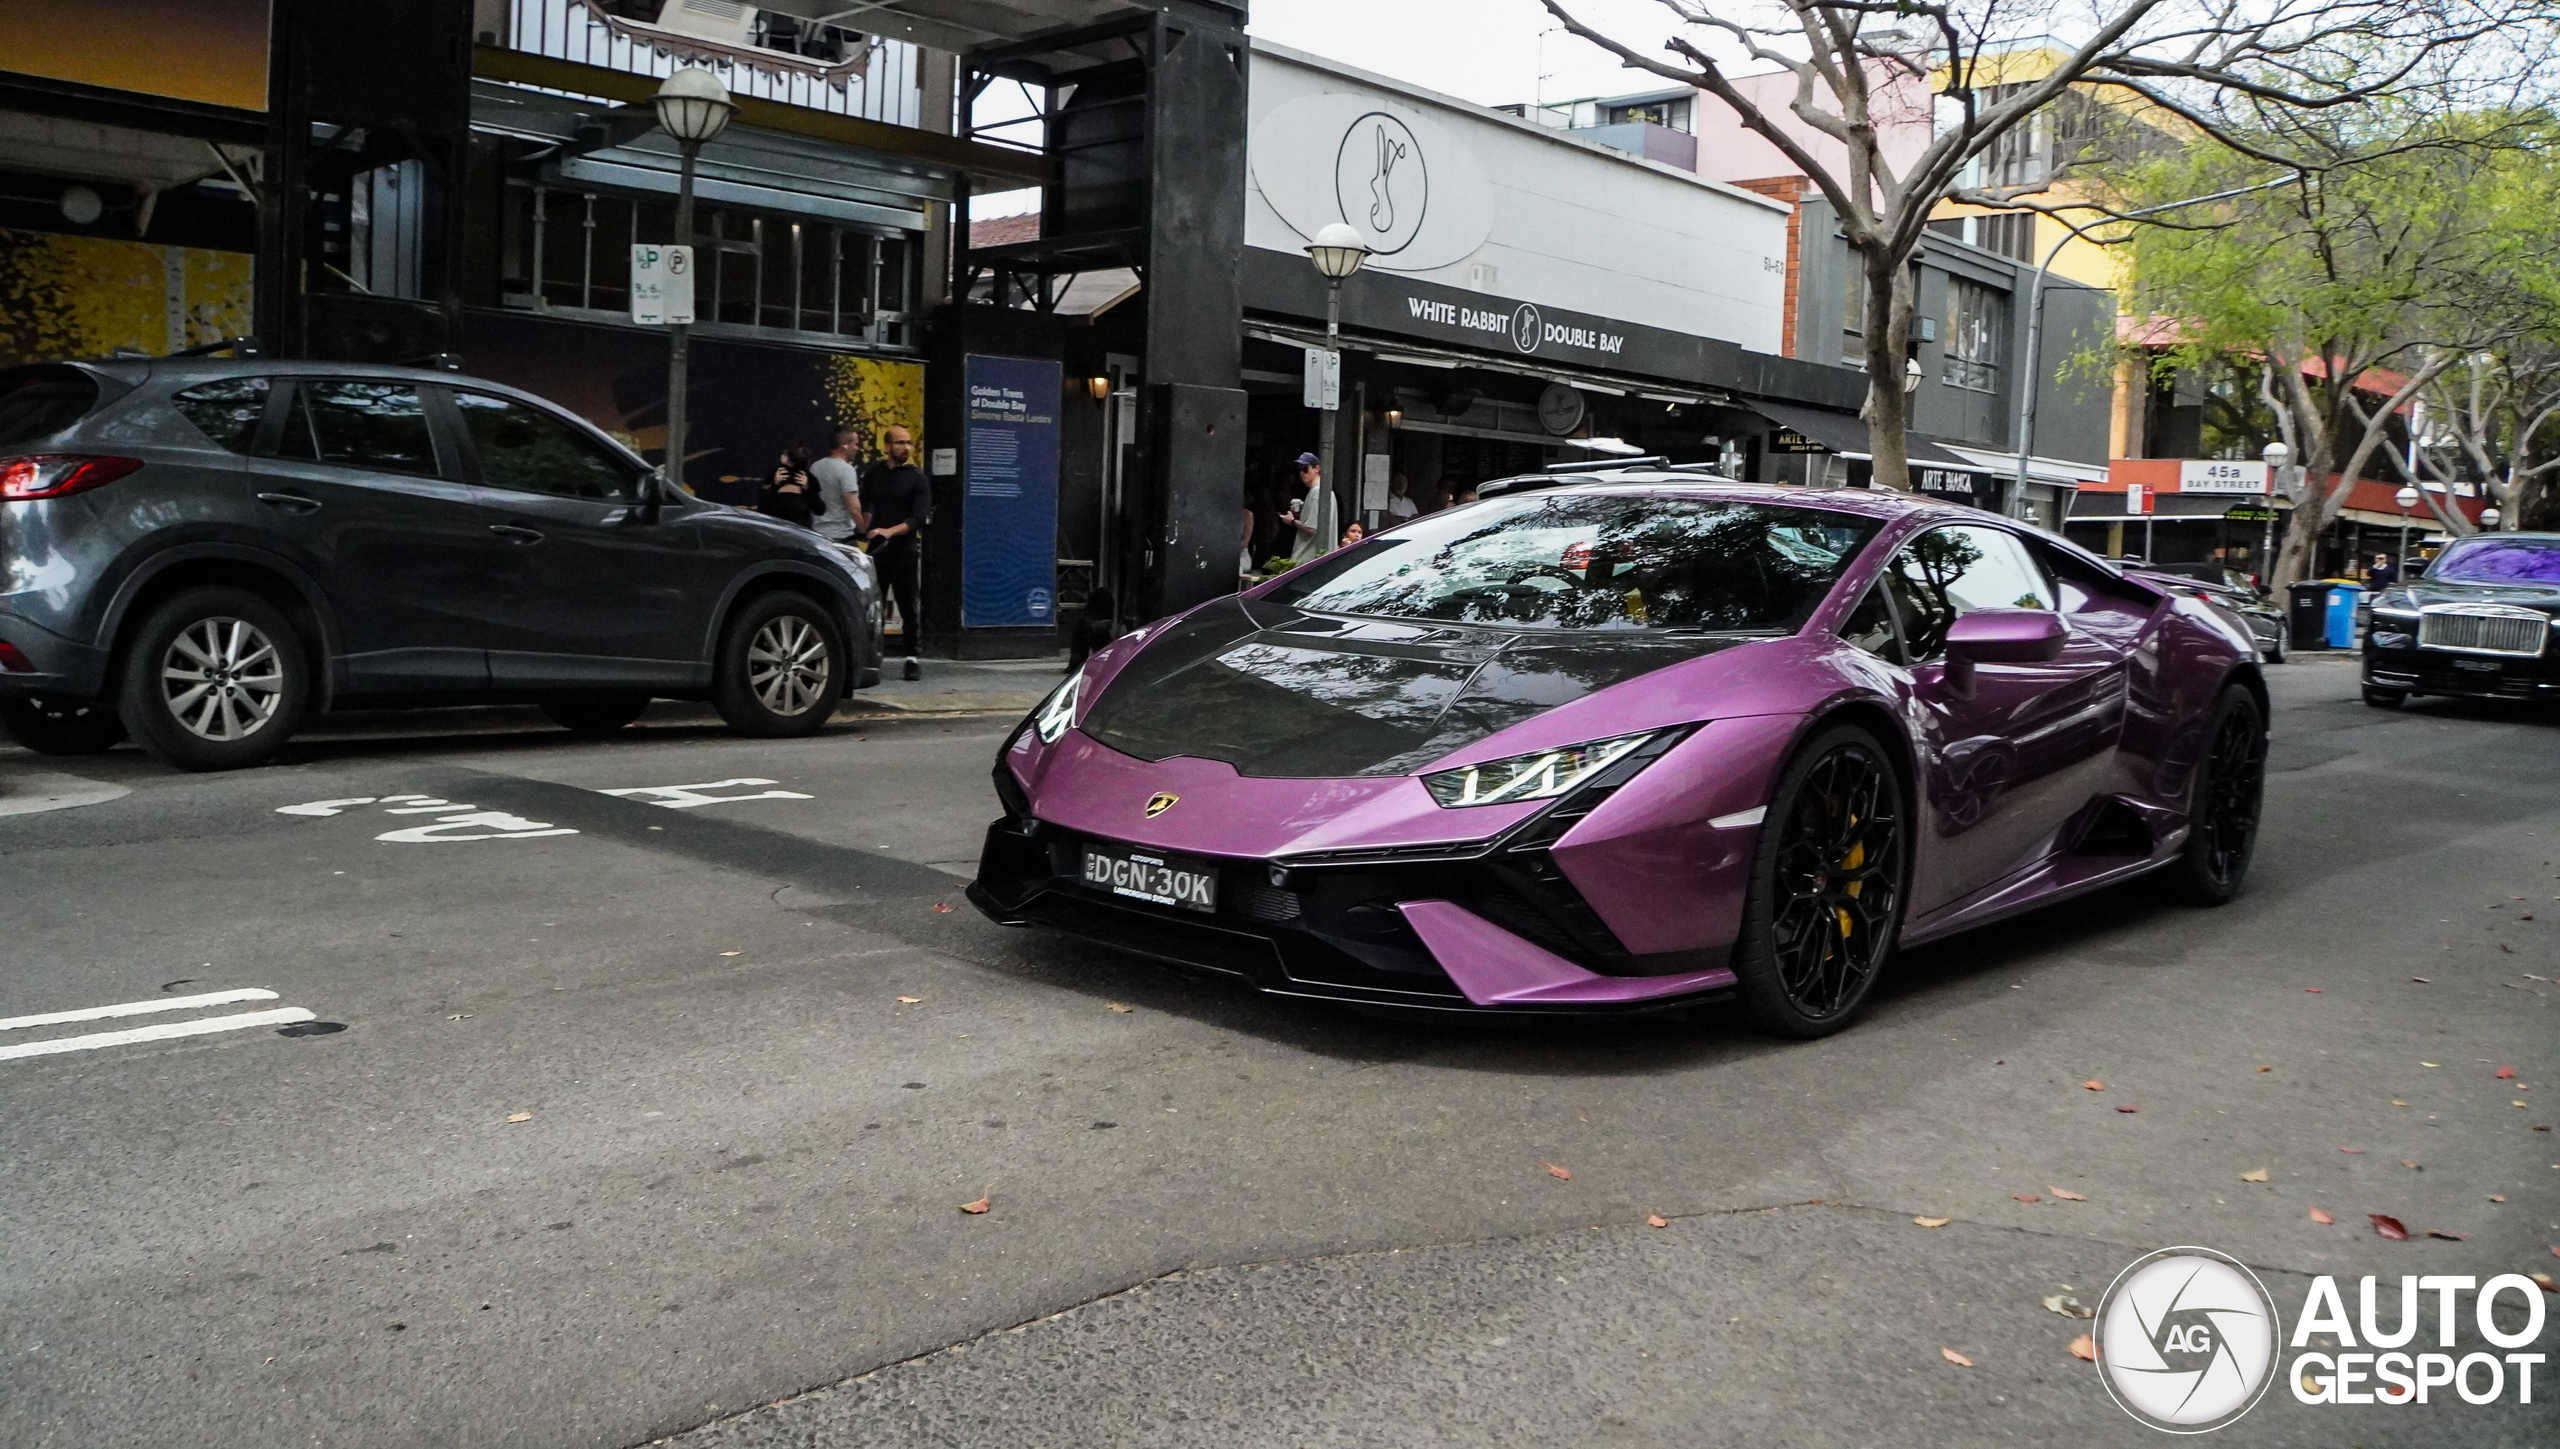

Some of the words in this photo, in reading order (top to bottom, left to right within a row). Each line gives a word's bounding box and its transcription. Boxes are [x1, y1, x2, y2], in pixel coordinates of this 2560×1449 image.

[1408, 297, 1456, 325] WHITE
[1460, 308, 1509, 334] RABBIT
[1544, 323, 1596, 349] DOUBLE
[1599, 333, 1624, 354] BAY
[971, 385, 1000, 397] Golden
[1002, 387, 1024, 399] Trees
[971, 398, 980, 407] of
[981, 398, 1010, 410] Double
[1011, 400, 1027, 412] Bay
[1778, 433, 1803, 445] ARTE
[2207, 466, 2241, 478] 45a
[1921, 469, 1943, 491] ARTE
[1945, 471, 1973, 494] BIANCA
[2187, 480, 2210, 488] BAY
[2214, 480, 2261, 489] STREET
